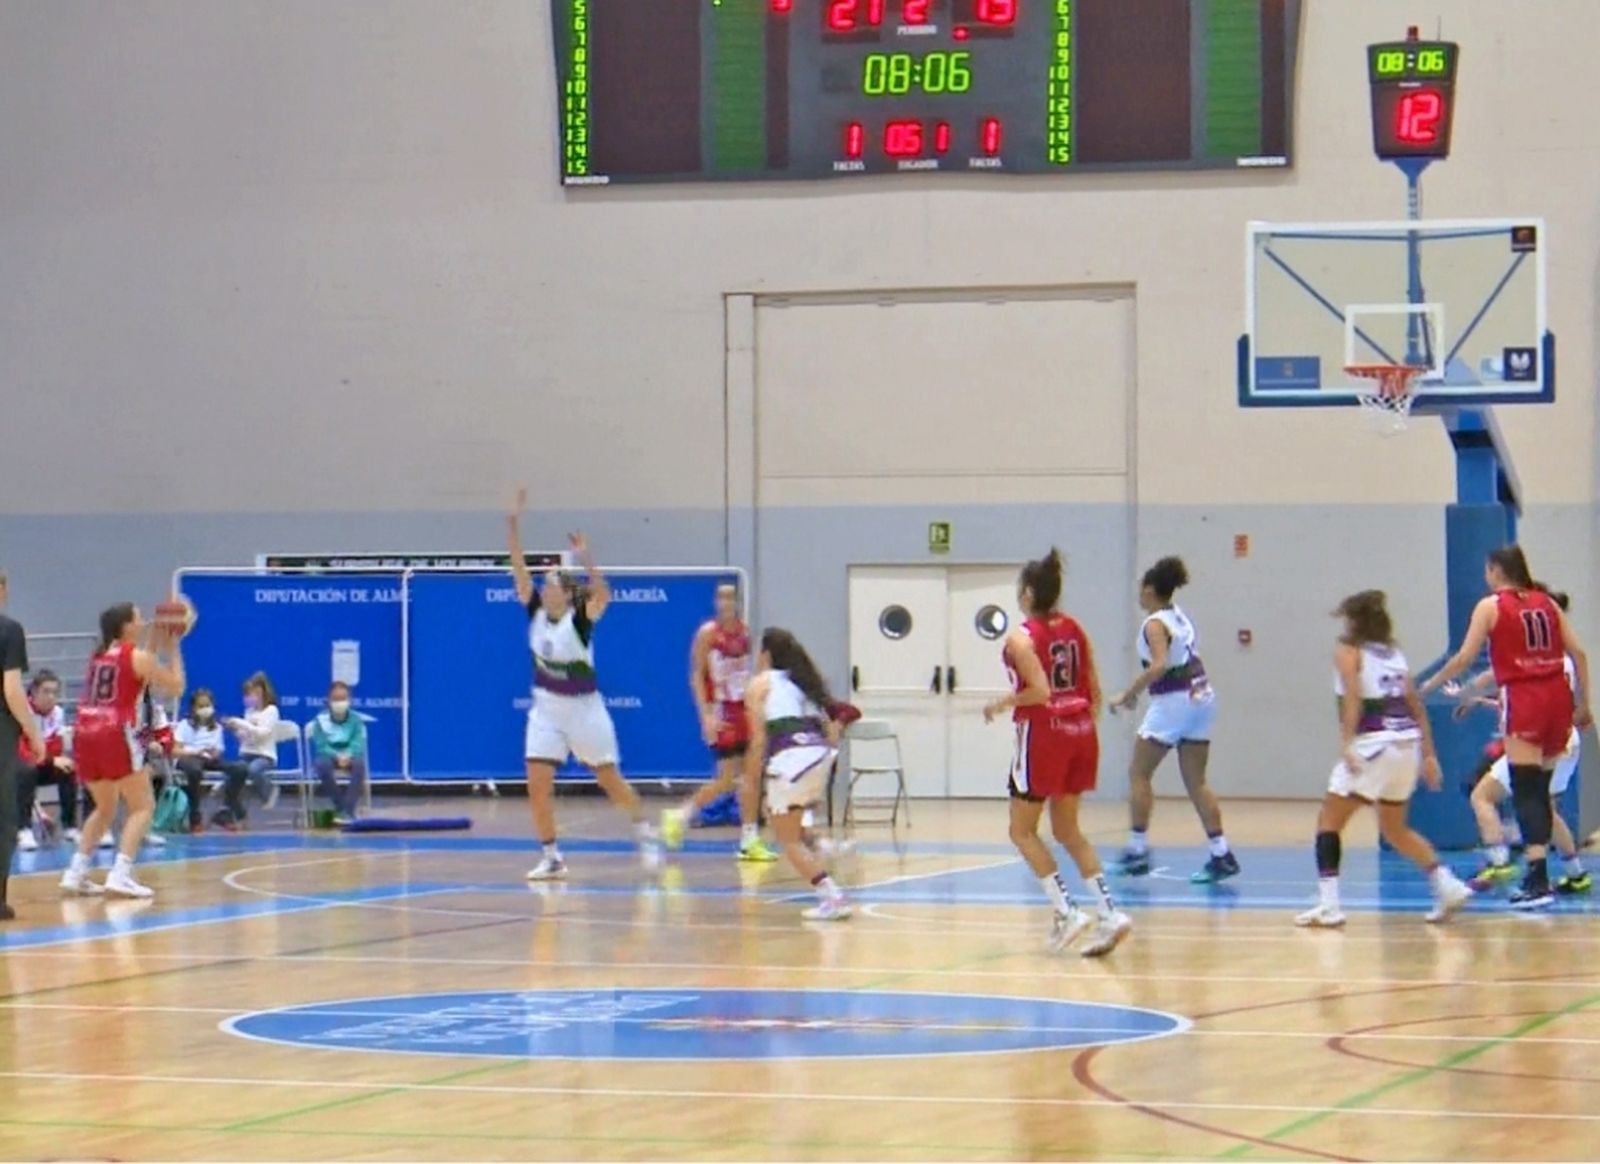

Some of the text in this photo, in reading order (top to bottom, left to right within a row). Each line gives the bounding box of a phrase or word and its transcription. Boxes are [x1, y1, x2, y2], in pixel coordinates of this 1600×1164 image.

[574, 15, 586, 31] 6
[1059, 15, 1070, 30] 7
[1056, 31, 1070, 48] 8
[573, 47, 586, 63] 8
[1057, 47, 1070, 64] 9
[1377, 50, 1445, 73] 08:06
[574, 62, 586, 79] 9
[864, 52, 970, 94] 08:06
[1049, 64, 1070, 81] 10
[566, 79, 587, 95] 10
[1048, 81, 1070, 96] 11
[566, 96, 587, 111] 11
[1048, 97, 1070, 114] 12
[567, 111, 586, 126] 12
[1048, 113, 1070, 130] 13
[1400, 94, 1440, 139] 12
[566, 126, 586, 143] 13
[849, 123, 862, 156] 1
[984, 120, 999, 154] 1
[1048, 131, 1070, 145] 14
[566, 144, 587, 158] 14
[1049, 146, 1069, 162] 15
[567, 159, 586, 174] 15
[254, 587, 347, 603] DIPUTACIÓN
[350, 588, 369, 602] DE
[1519, 609, 1551, 652] 11
[1049, 640, 1079, 692] 21
[87, 663, 120, 705] 18
